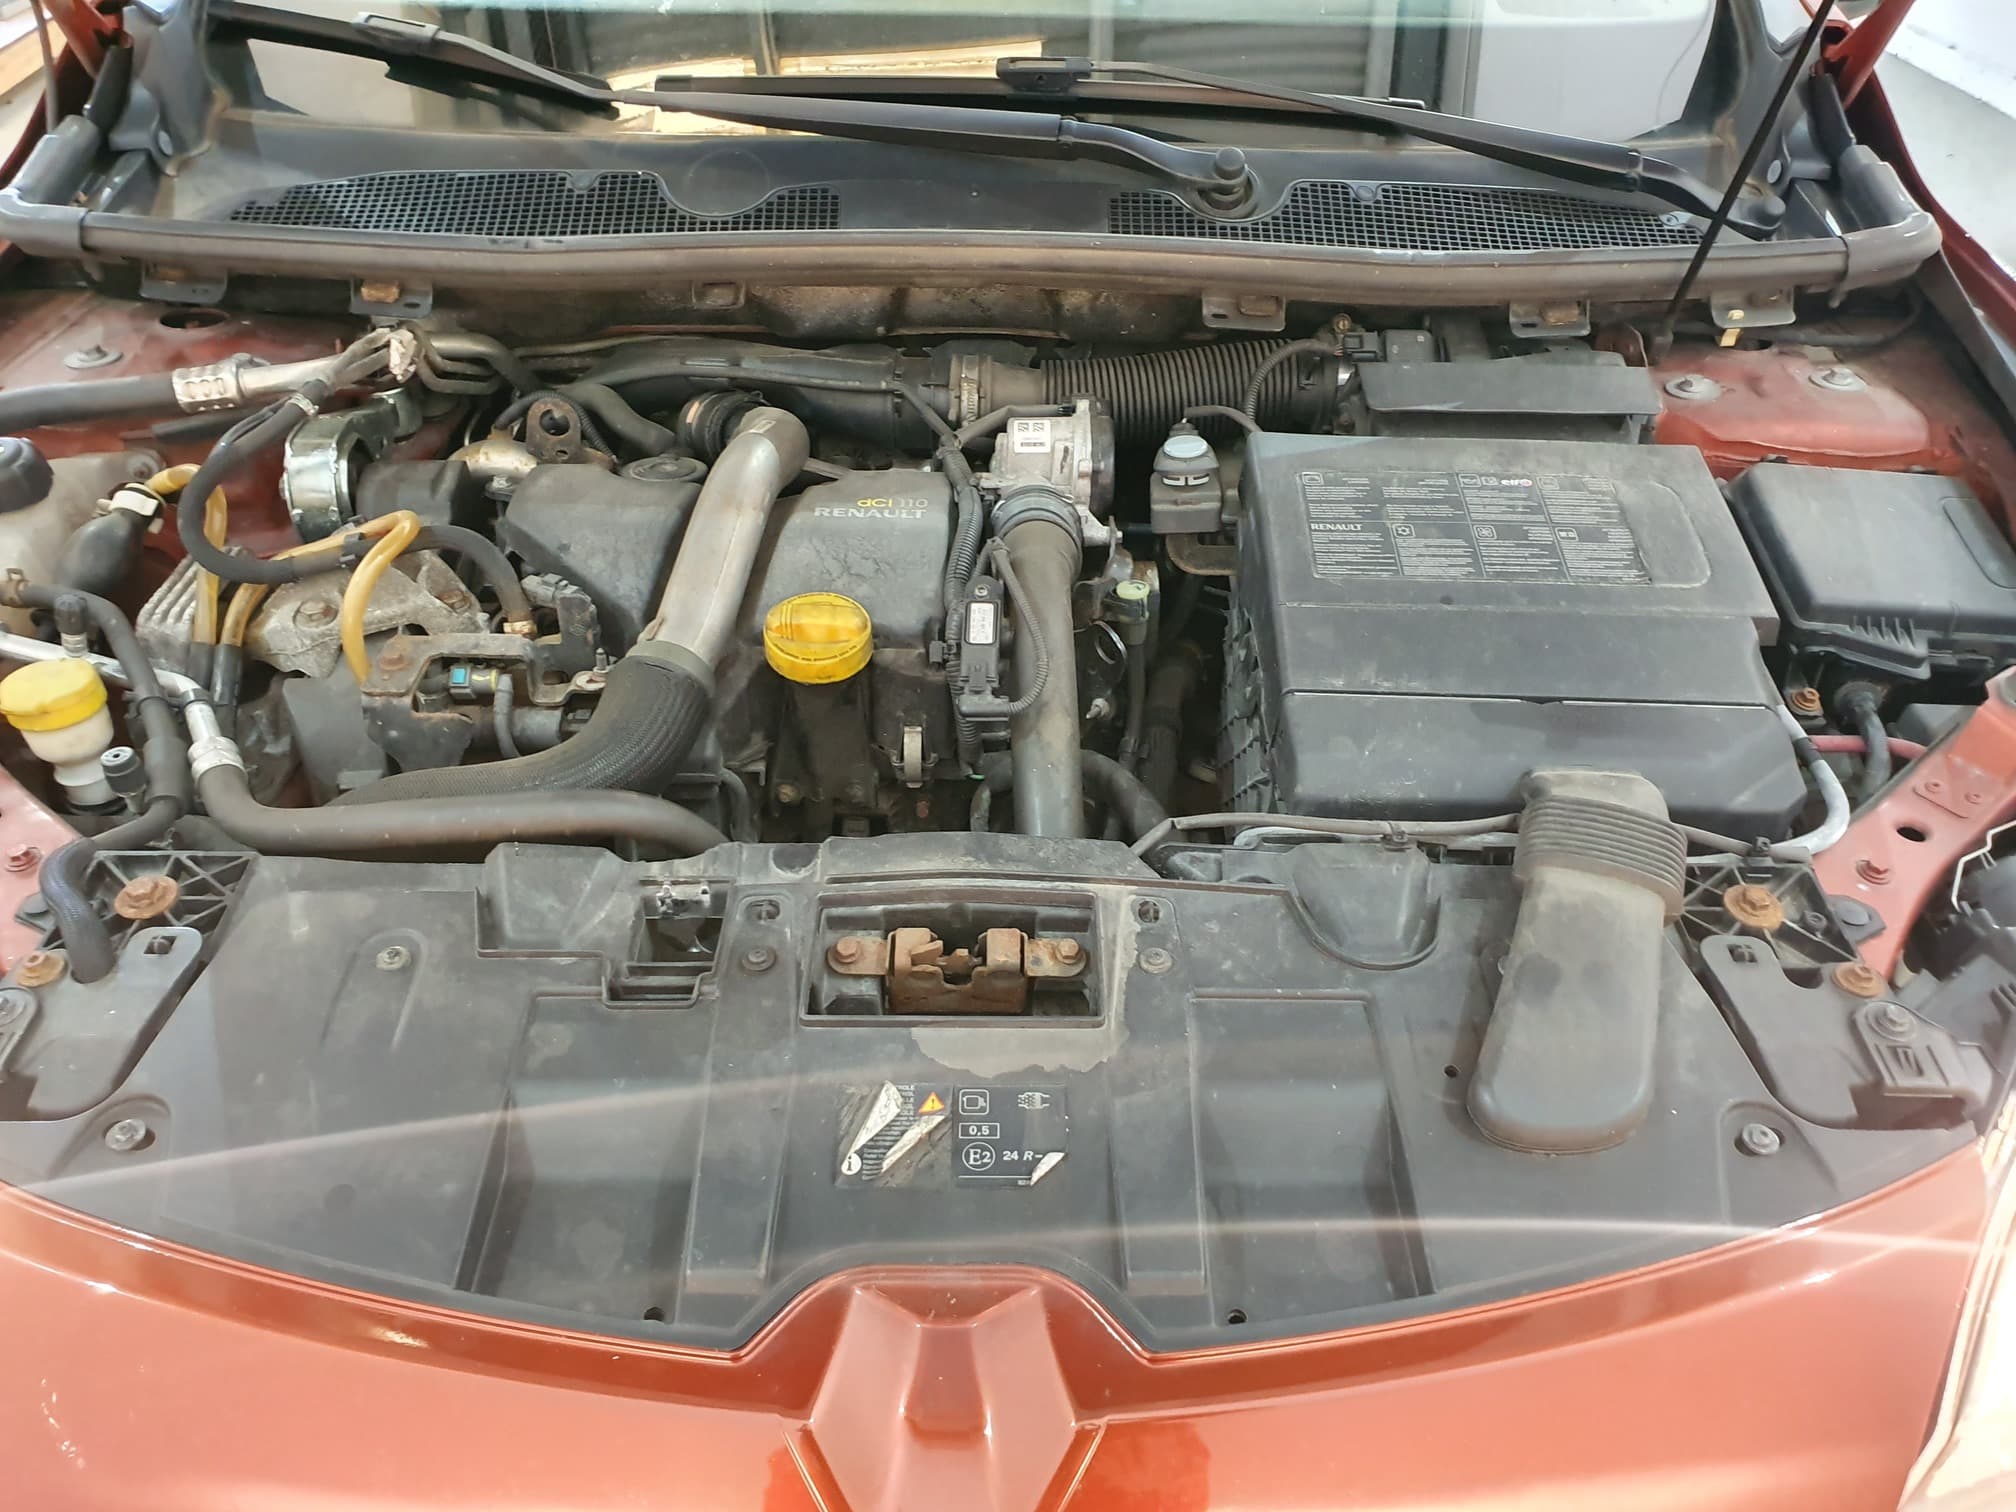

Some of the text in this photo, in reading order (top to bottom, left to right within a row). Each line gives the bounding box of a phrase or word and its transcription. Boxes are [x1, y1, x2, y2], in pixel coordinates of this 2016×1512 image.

[814, 508, 927, 519] RENAULT
[1310, 523, 1362, 531] RENAULT
[968, 1148, 992, 1165] E2
[1002, 1150, 1019, 1161] 24
